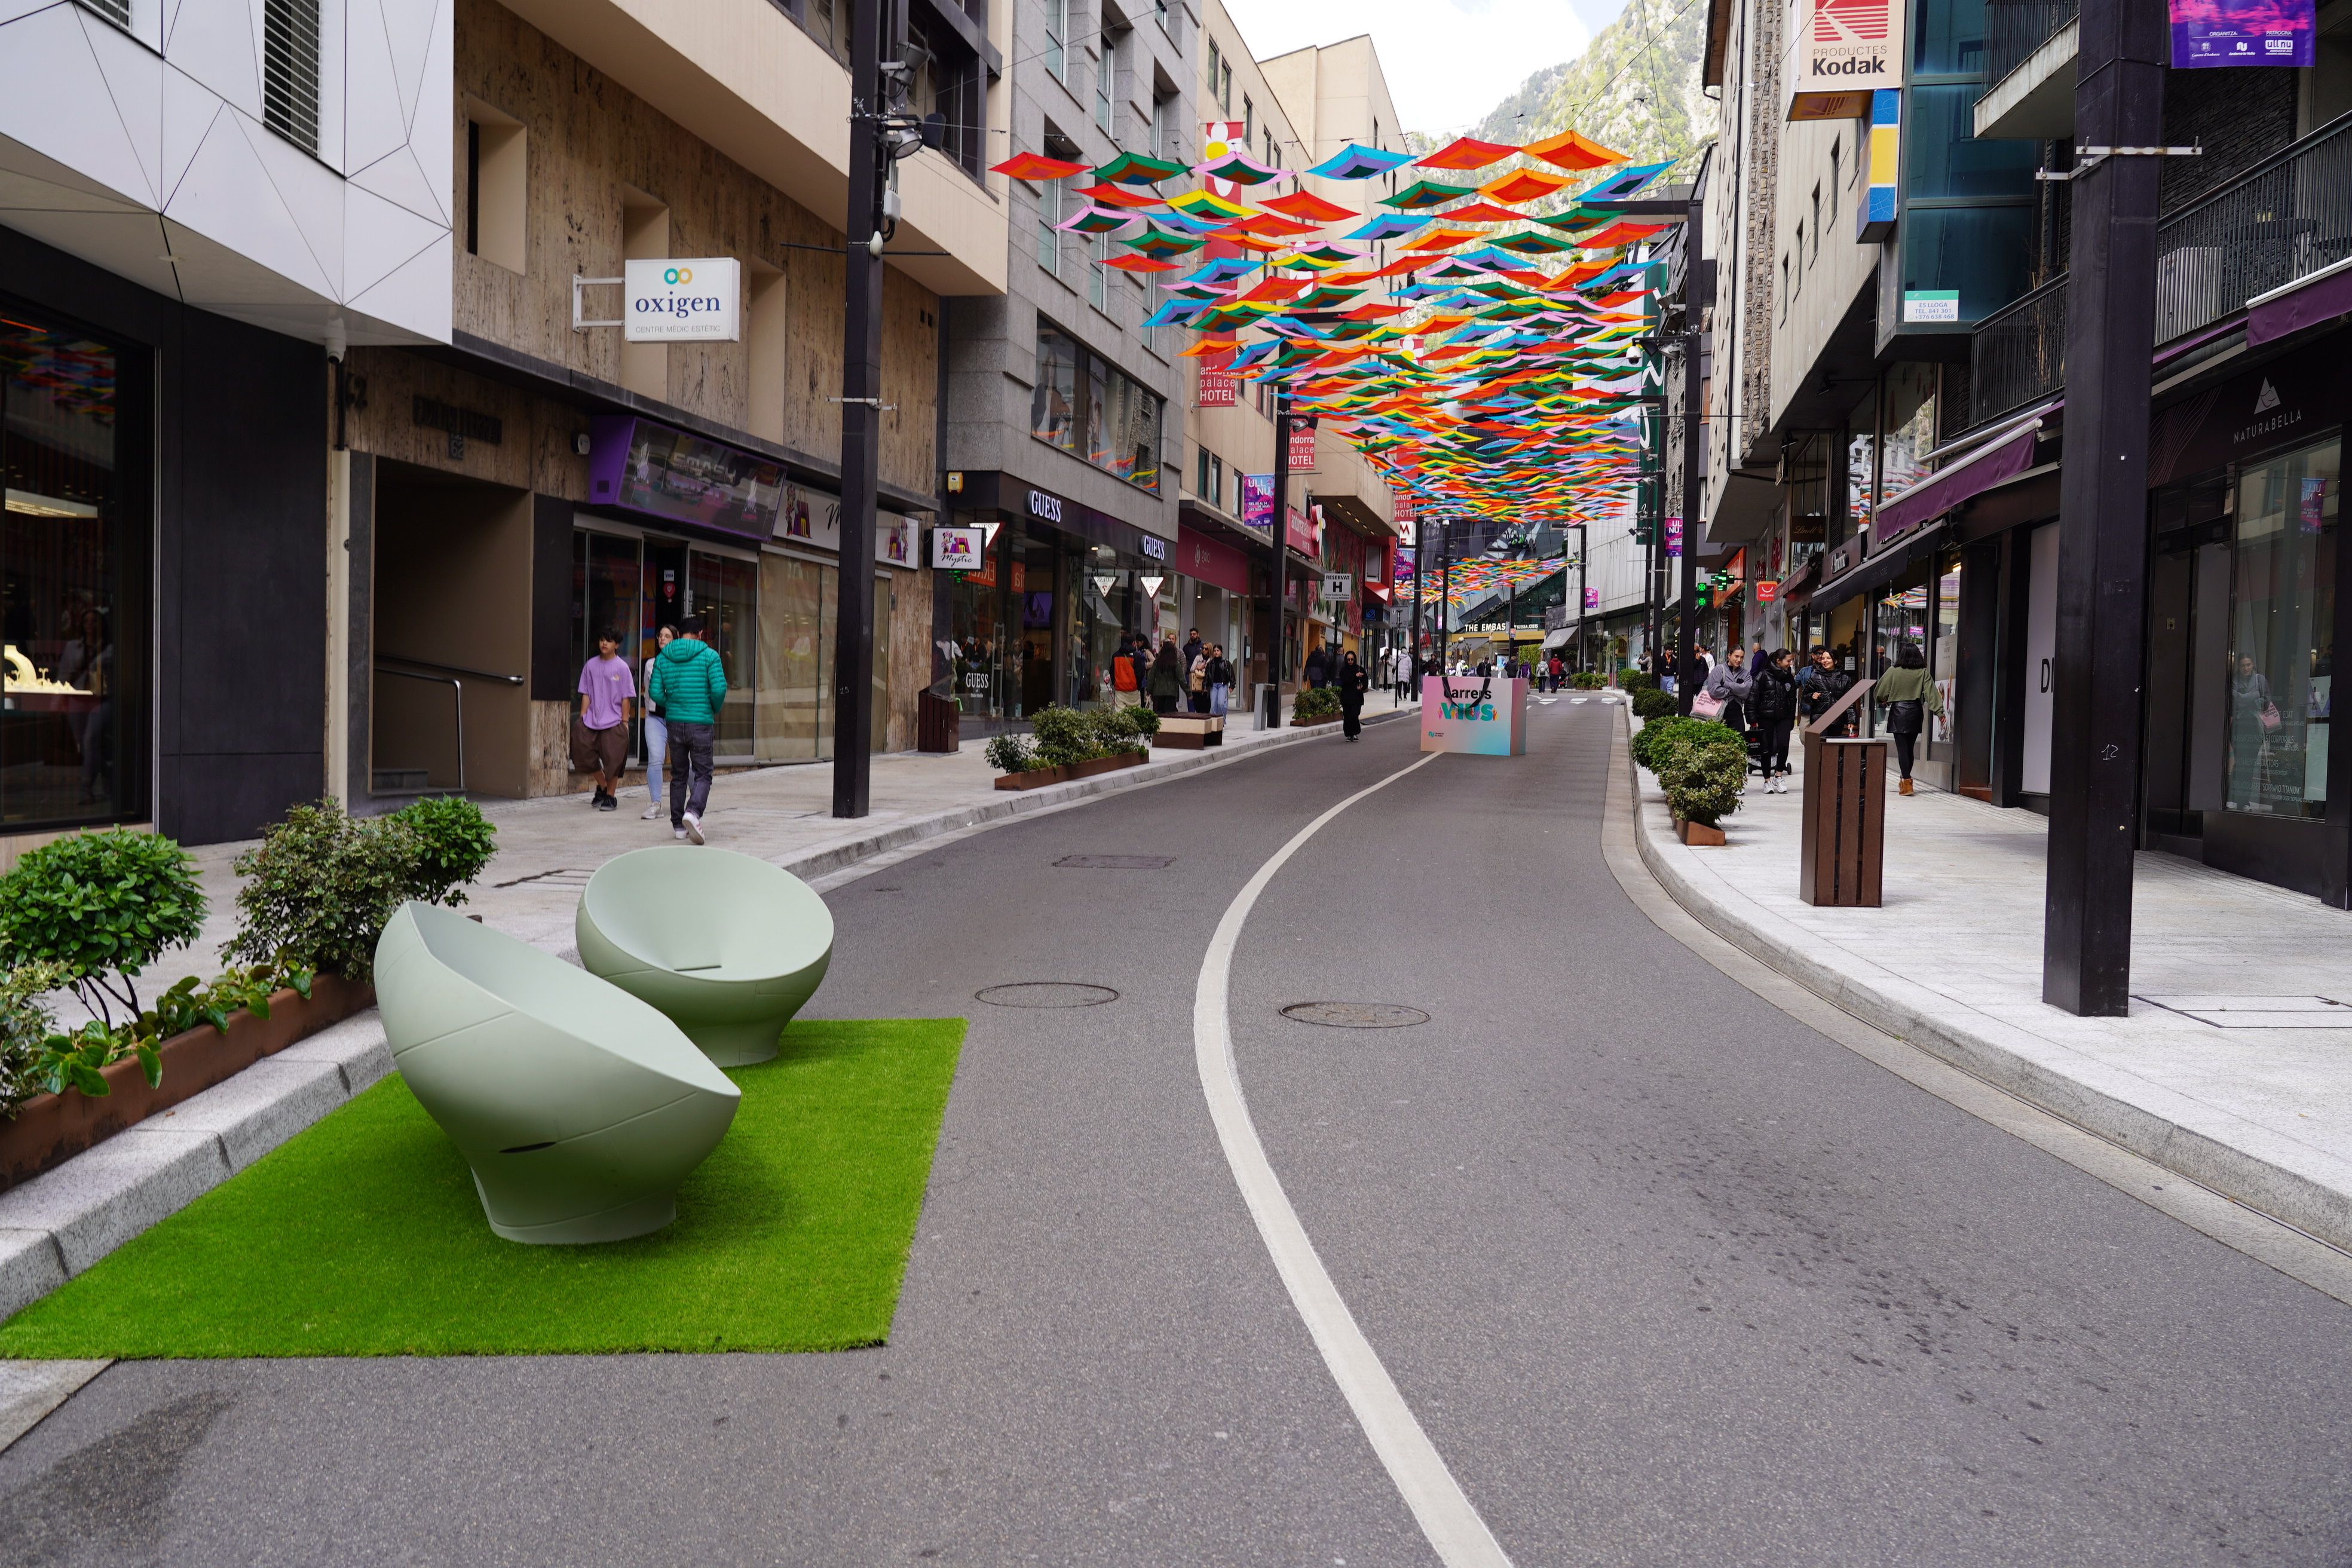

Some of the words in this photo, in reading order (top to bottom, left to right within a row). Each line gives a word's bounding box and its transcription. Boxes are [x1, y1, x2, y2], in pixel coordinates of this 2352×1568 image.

[1813, 45, 1887, 57] PRODUCTES
[1812, 56, 1886, 76] Kodak
[635, 291, 721, 318] oxigen
[1200, 378, 1235, 388] palace
[1200, 390, 1235, 402] HOTEL
[2234, 409, 2301, 444] NATURABELLA
[1290, 436, 1315, 444] ndorra
[1291, 445, 1314, 454] alace
[1248, 479, 1266, 488] ULL
[1257, 486, 1270, 496] NU
[1031, 490, 1061, 523] GUESS
[1144, 535, 1165, 561] GUESS
[941, 554, 973, 567] Mystic
[1333, 581, 1342, 593] H
[1465, 623, 1478, 632] THE
[1481, 622, 1506, 632] EMBAS
[966, 672, 989, 688] GUESS
